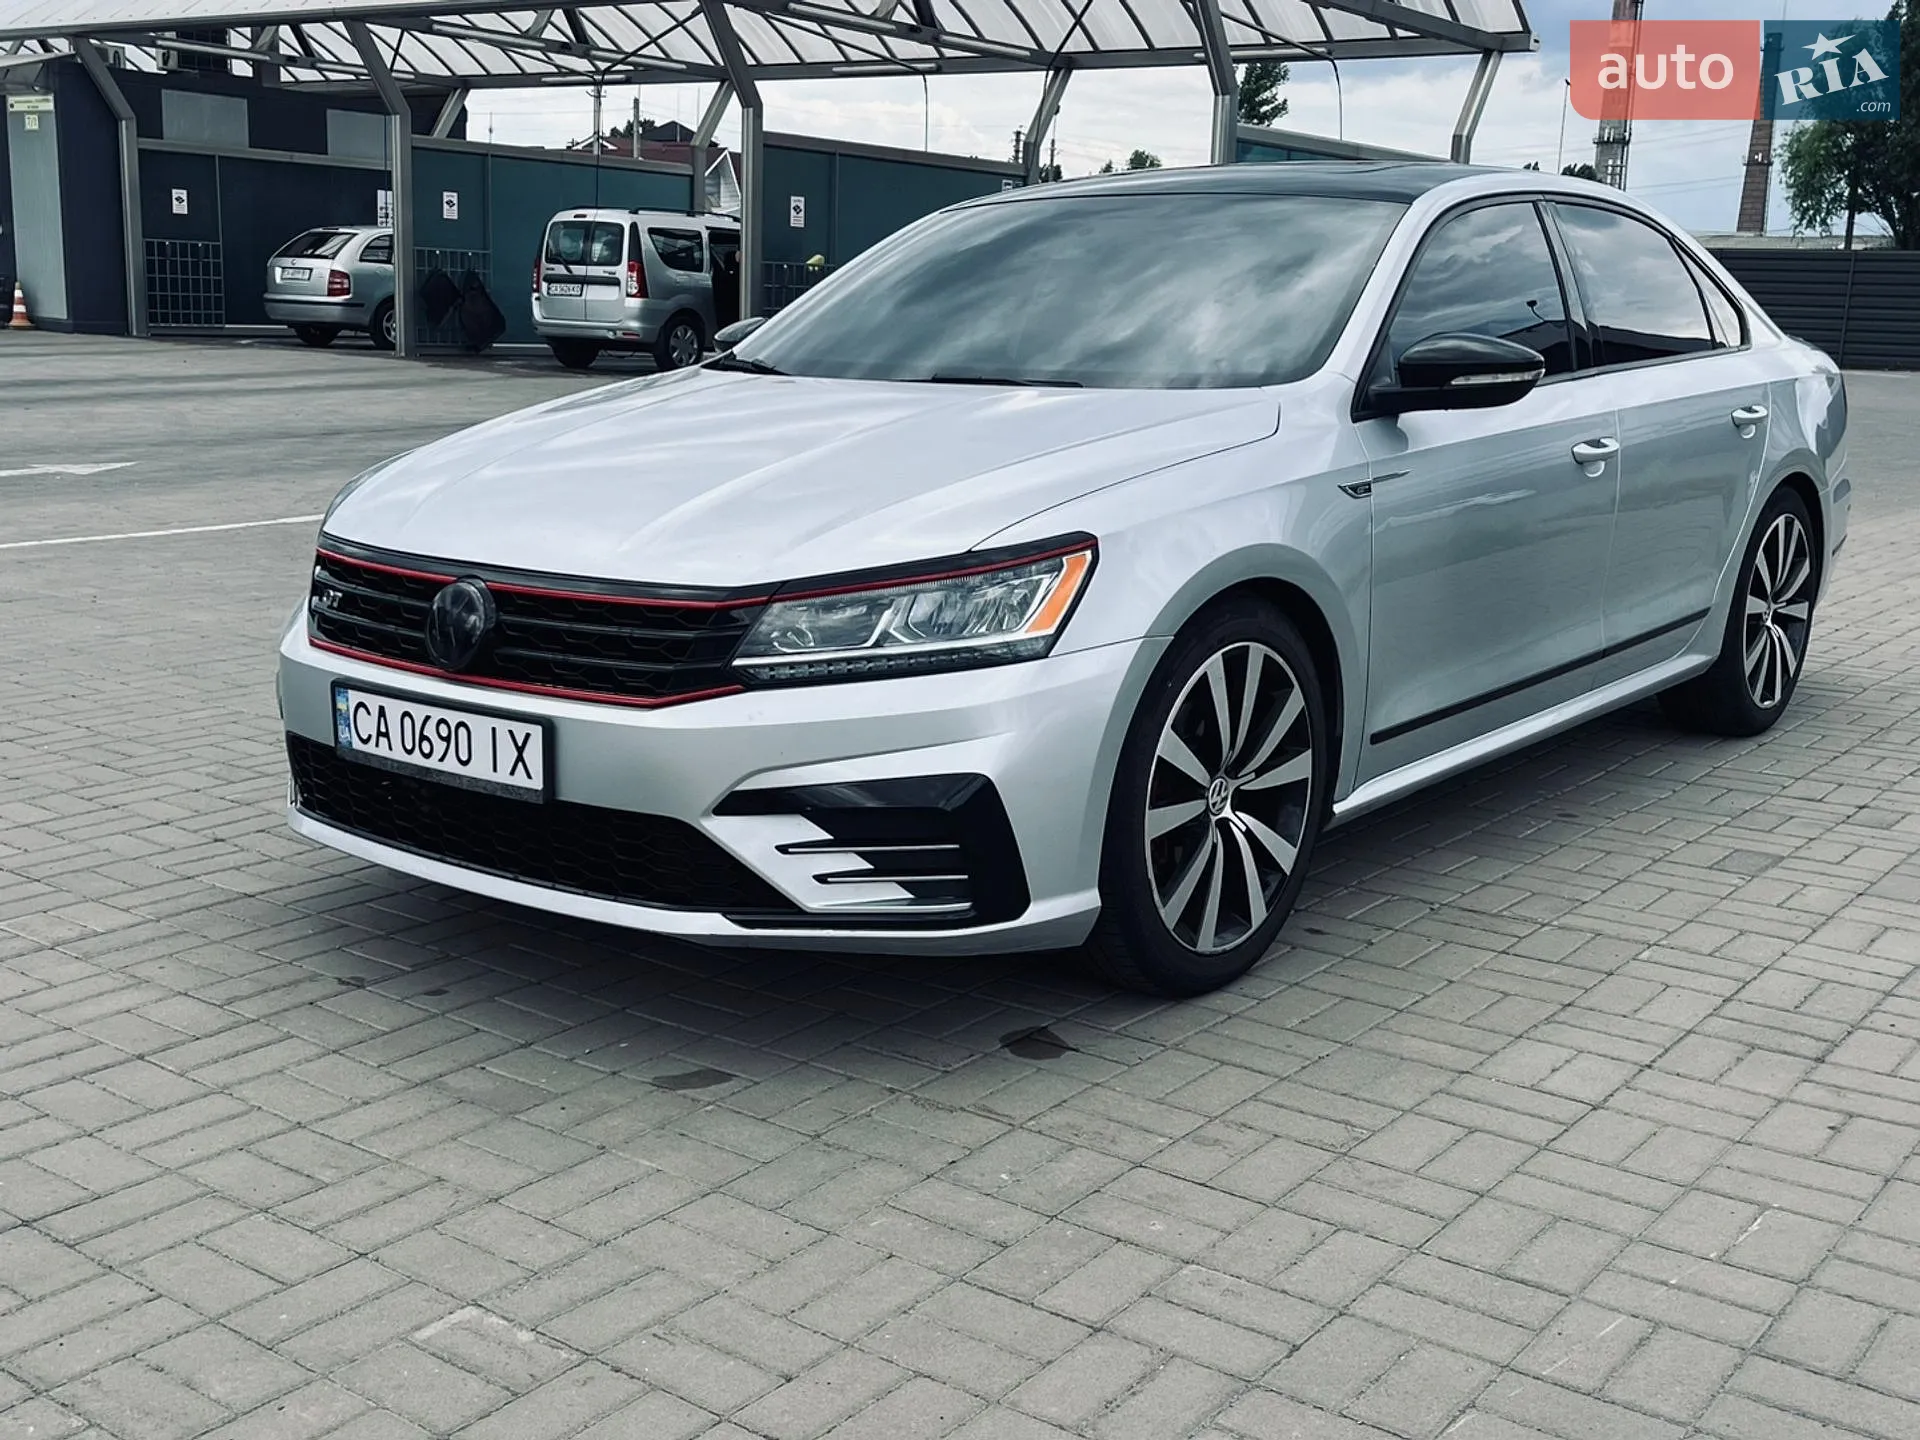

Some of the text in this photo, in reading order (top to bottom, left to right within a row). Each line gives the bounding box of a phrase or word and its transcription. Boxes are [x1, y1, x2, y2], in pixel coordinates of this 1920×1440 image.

[353, 702, 533, 780] CA 0690 IX
